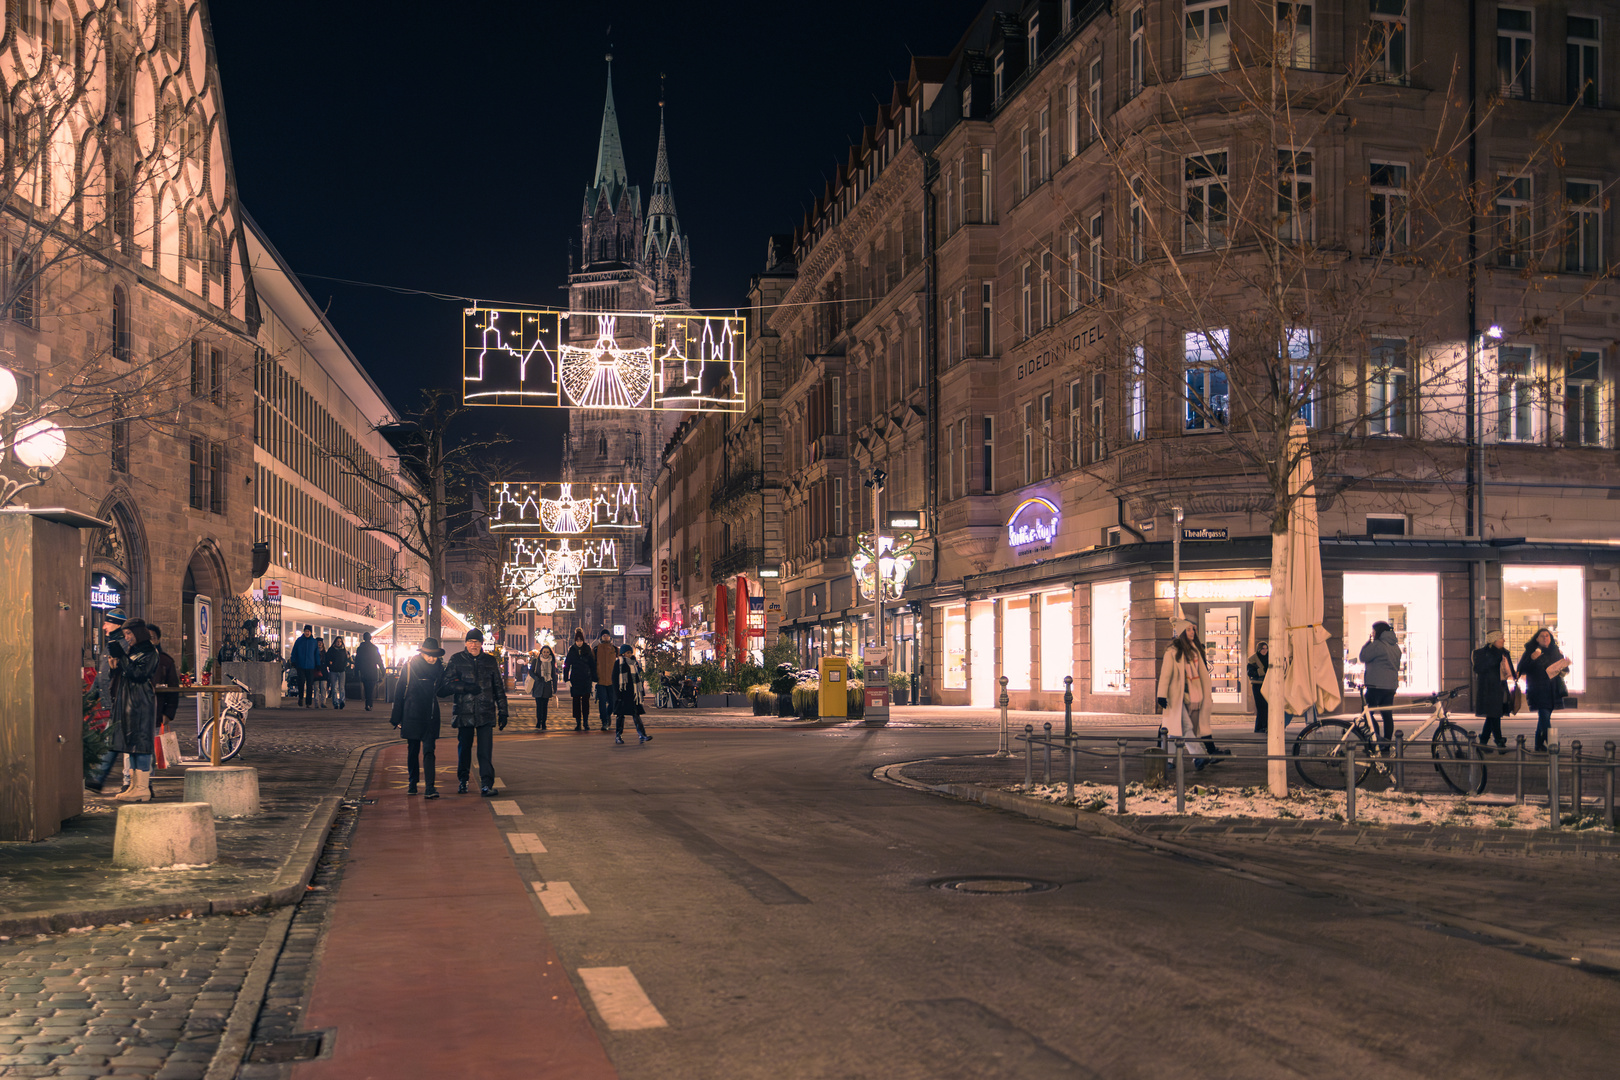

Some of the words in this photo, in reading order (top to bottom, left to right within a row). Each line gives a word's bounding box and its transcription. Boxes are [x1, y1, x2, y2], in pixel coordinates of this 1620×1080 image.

[1017, 345, 1059, 380] GIDEON
[1063, 324, 1104, 358] HOTEL
[1183, 529, 1226, 538] Theatergasse
